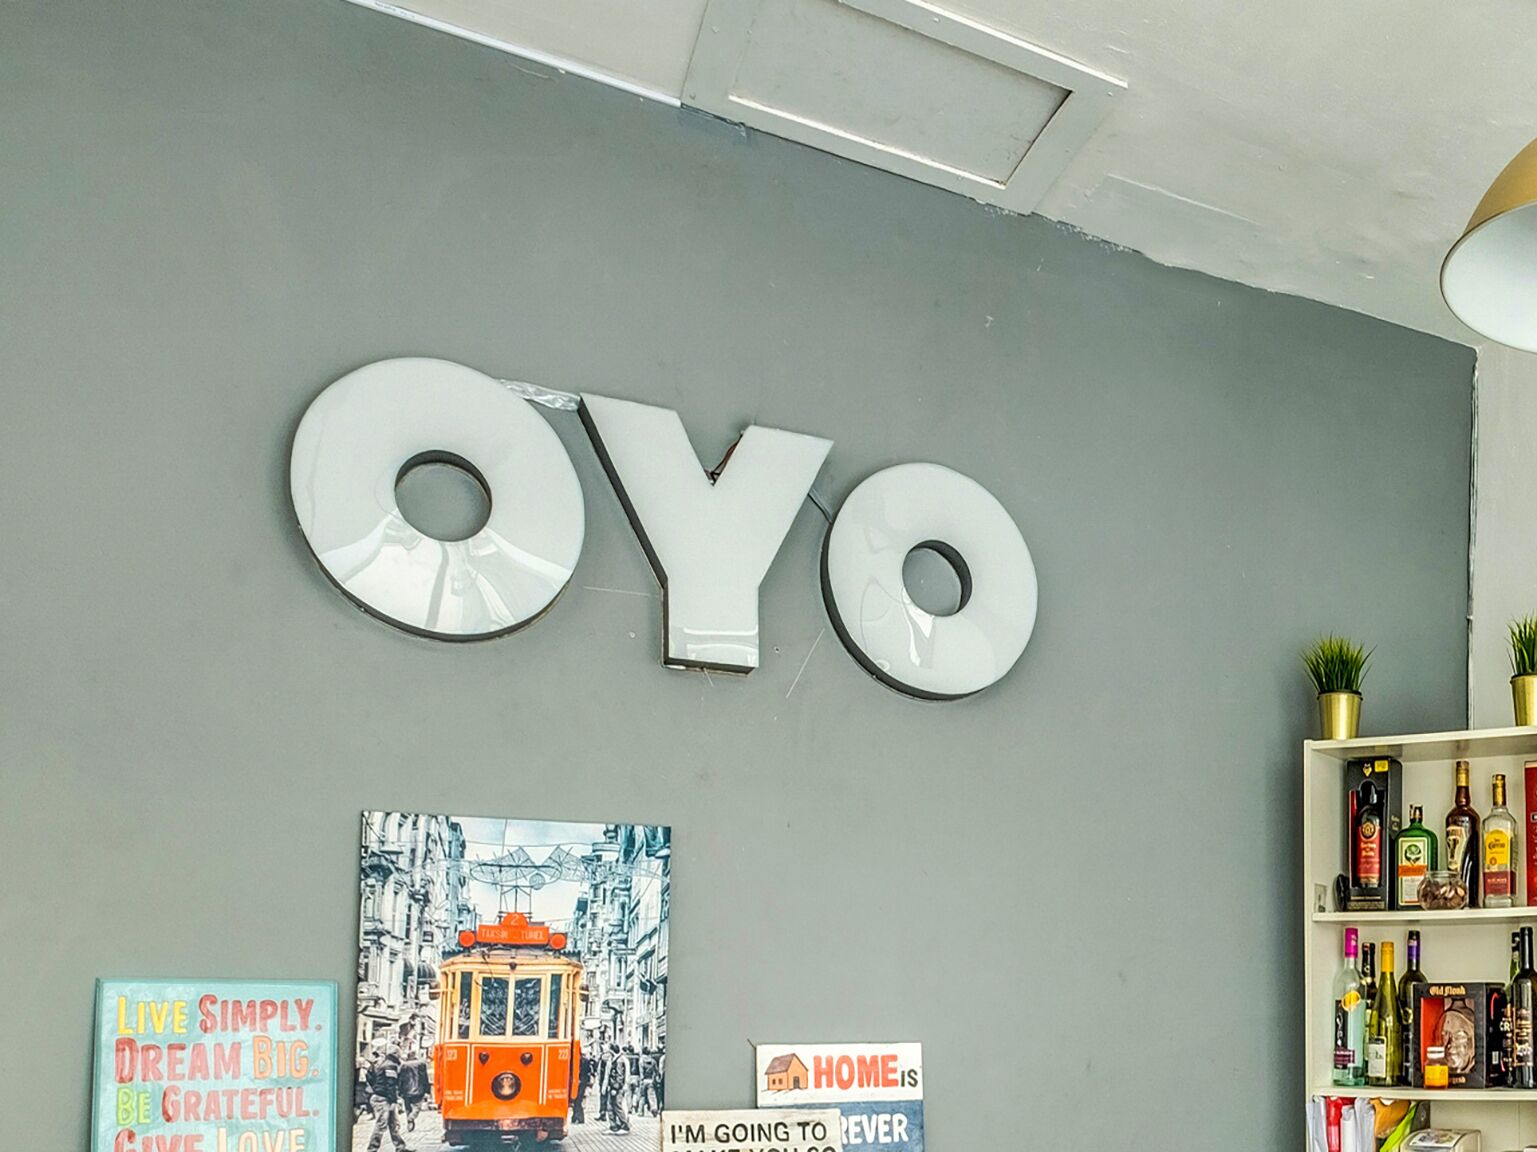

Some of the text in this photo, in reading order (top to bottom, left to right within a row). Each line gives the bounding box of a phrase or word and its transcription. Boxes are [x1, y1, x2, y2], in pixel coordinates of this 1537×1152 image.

[290, 357, 1038, 700] OYO
[116, 993, 322, 1035] LIVE SIMPLY.
[114, 1034, 319, 1084] DREAM BIG.
[813, 1054, 899, 1090] HOME
[116, 1085, 320, 1126] BE GRATEFUL.
[671, 1121, 828, 1144] I'M GOING TO
